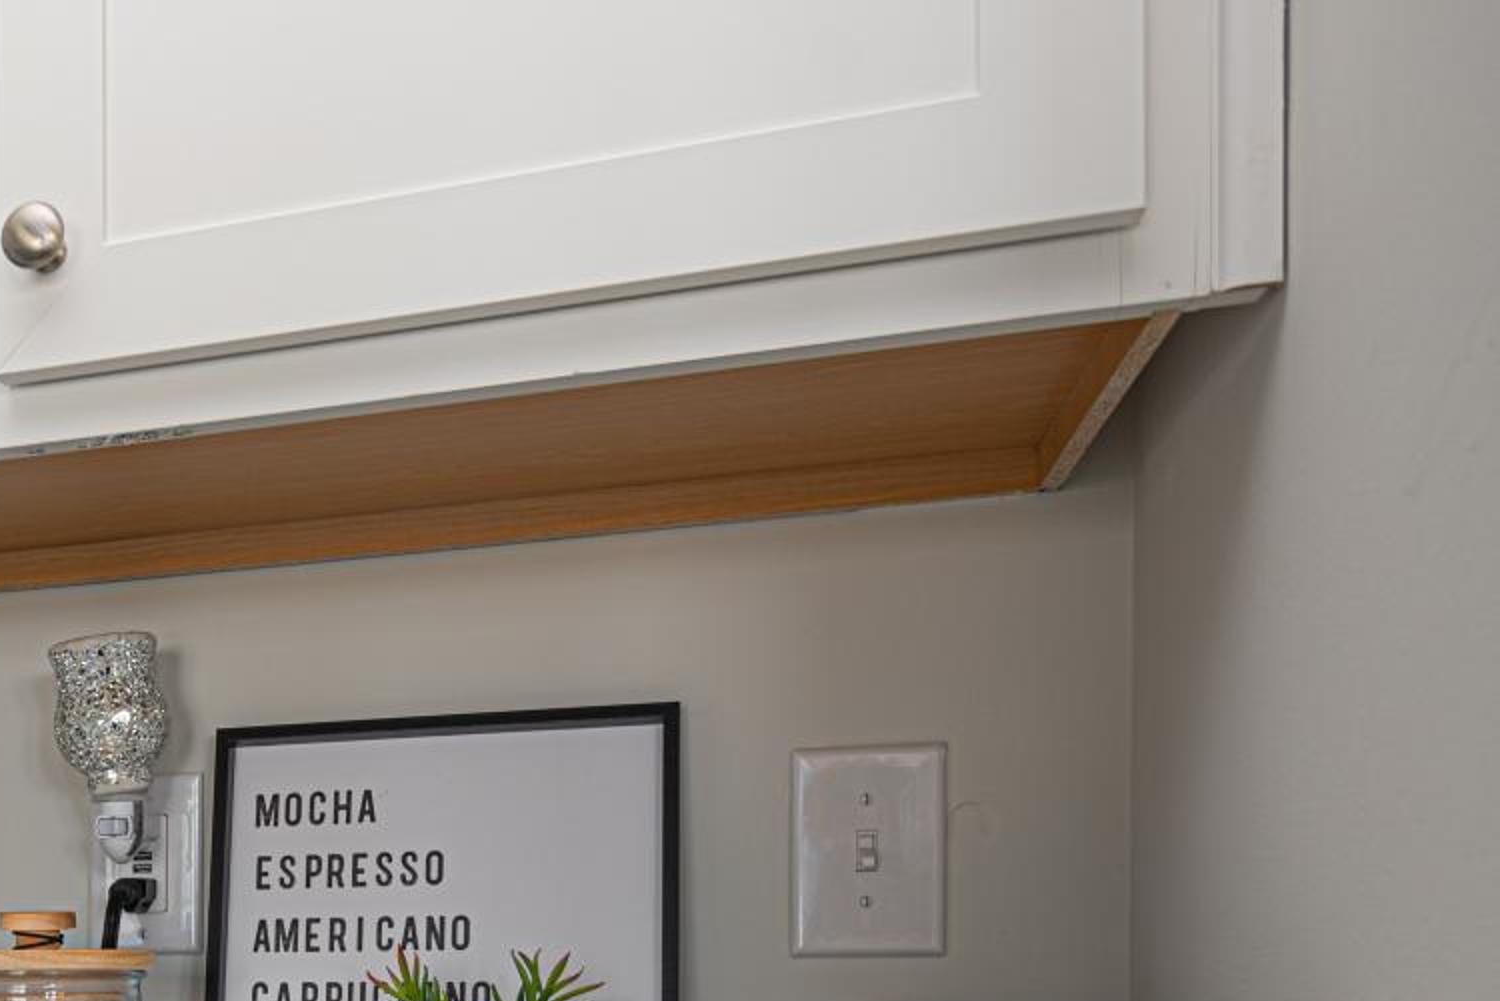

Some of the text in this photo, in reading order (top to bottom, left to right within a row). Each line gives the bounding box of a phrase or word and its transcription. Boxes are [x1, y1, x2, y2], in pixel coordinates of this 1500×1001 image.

[255, 789, 376, 828] MOCHA
[255, 850, 445, 891] ESPRESSO
[253, 915, 471, 953] AMERICANO
